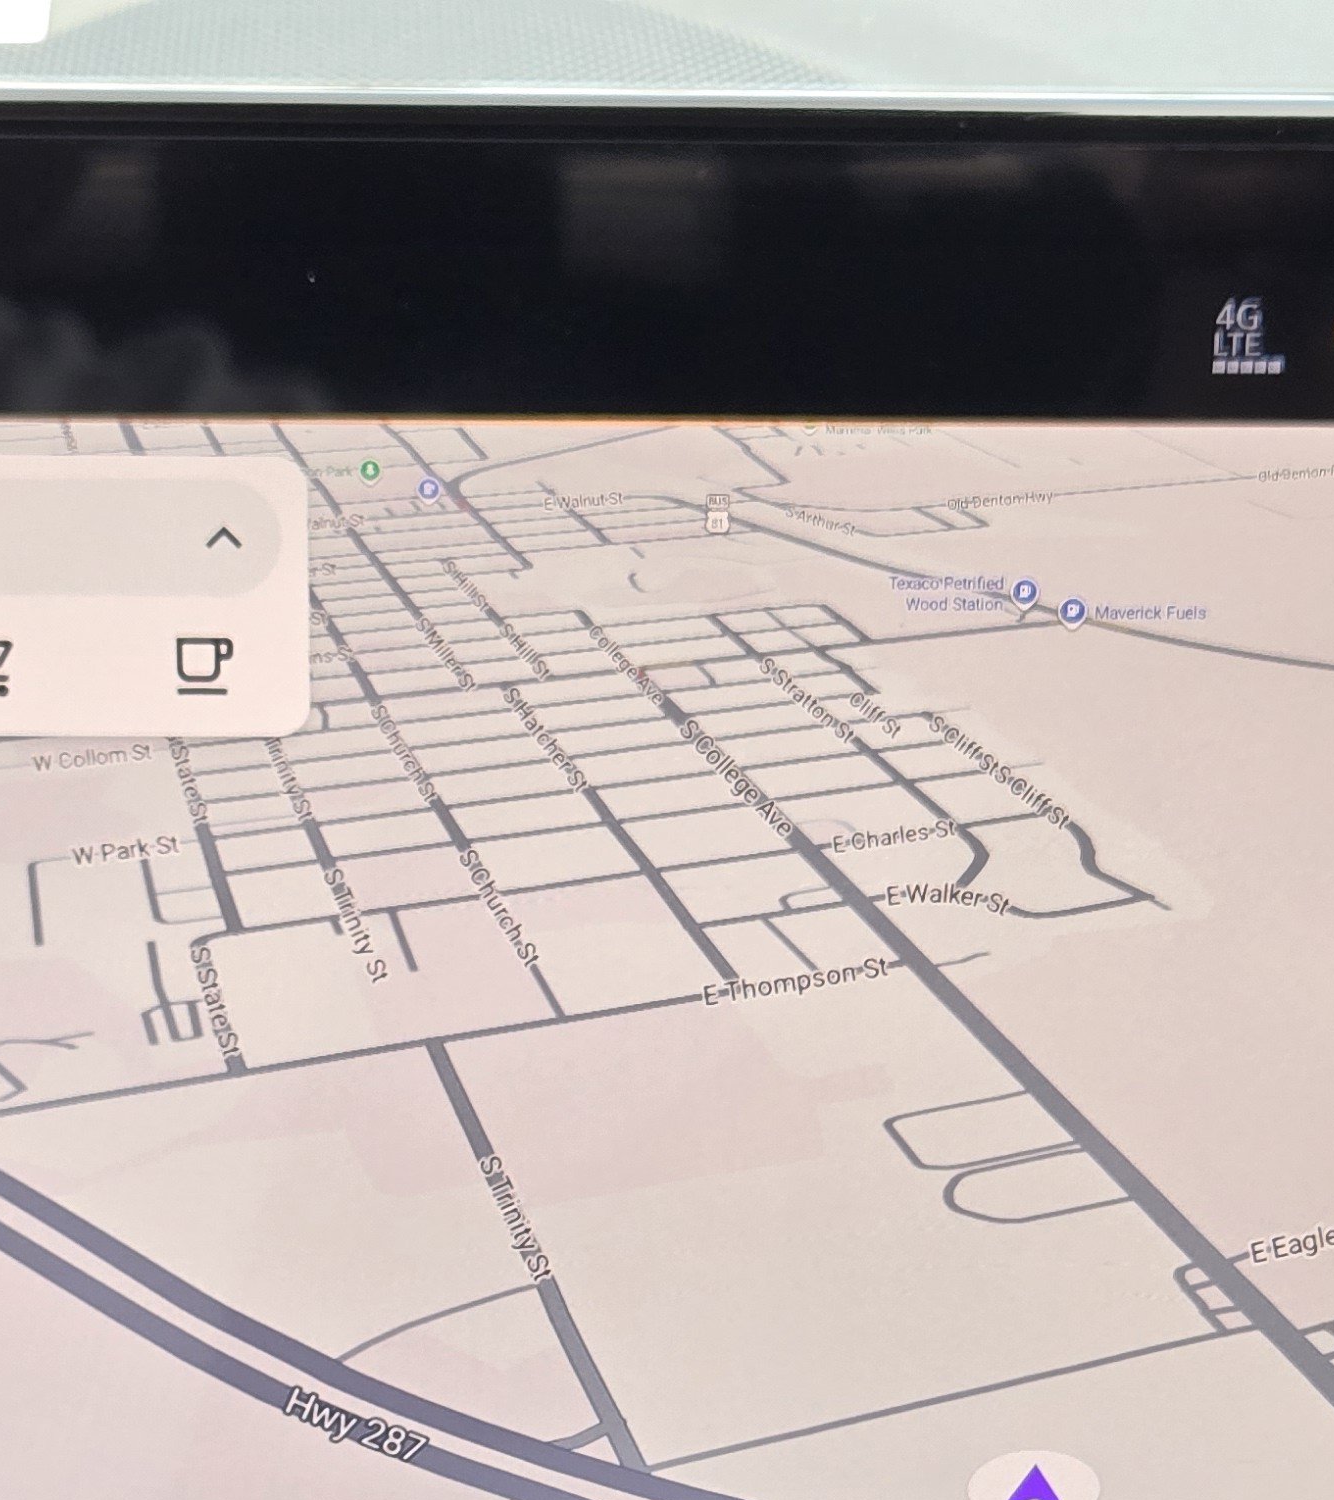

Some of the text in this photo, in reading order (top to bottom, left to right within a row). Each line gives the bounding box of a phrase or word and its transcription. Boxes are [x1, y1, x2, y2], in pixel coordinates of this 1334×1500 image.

[1214, 298, 1263, 331] 4G
[1212, 332, 1262, 358] LTE
[543, 491, 624, 511] E Walnut St
[708, 496, 728, 506] BUS
[972, 492, 1022, 510] Denton
[1024, 489, 1055, 506] Hwy
[349, 513, 365, 528] St
[710, 517, 725, 530] 81
[797, 509, 840, 532] Arthur
[840, 521, 857, 537] St
[322, 562, 337, 576] St
[444, 560, 490, 613] S Hill St
[889, 575, 1006, 592] Texaco Petrified
[311, 611, 329, 627] St
[905, 596, 1004, 612] Wood Station
[1094, 604, 1208, 621] Maverick Fuels
[416, 617, 476, 692] S Miller St
[500, 622, 550, 680] S Hill St
[588, 625, 664, 706] College Ave
[758, 657, 855, 744] S Stratton St
[848, 691, 902, 740] Cliff St
[31, 743, 152, 772] W Collom St
[370, 703, 438, 803] S Church St
[503, 687, 588, 793] S Hatcher St
[929, 715, 999, 775] S Cliff St
[170, 745, 200, 800] State
[189, 800, 208, 825] St
[680, 719, 793, 837] S College Ave
[293, 798, 313, 822] St
[993, 765, 1070, 831] S Cliff St
[71, 835, 180, 866] W Park St
[832, 818, 957, 855] E Charles St
[459, 848, 541, 969] S Church St
[885, 883, 1013, 917] E Walker St
[323, 867, 389, 984] S Trinity St
[702, 957, 889, 1007] E Thompson St
[190, 944, 242, 1058] S State St
[480, 1155, 552, 1282] S Trinity St
[1250, 1241, 1269, 1264] E
[283, 1385, 431, 1463] Hwy 287
